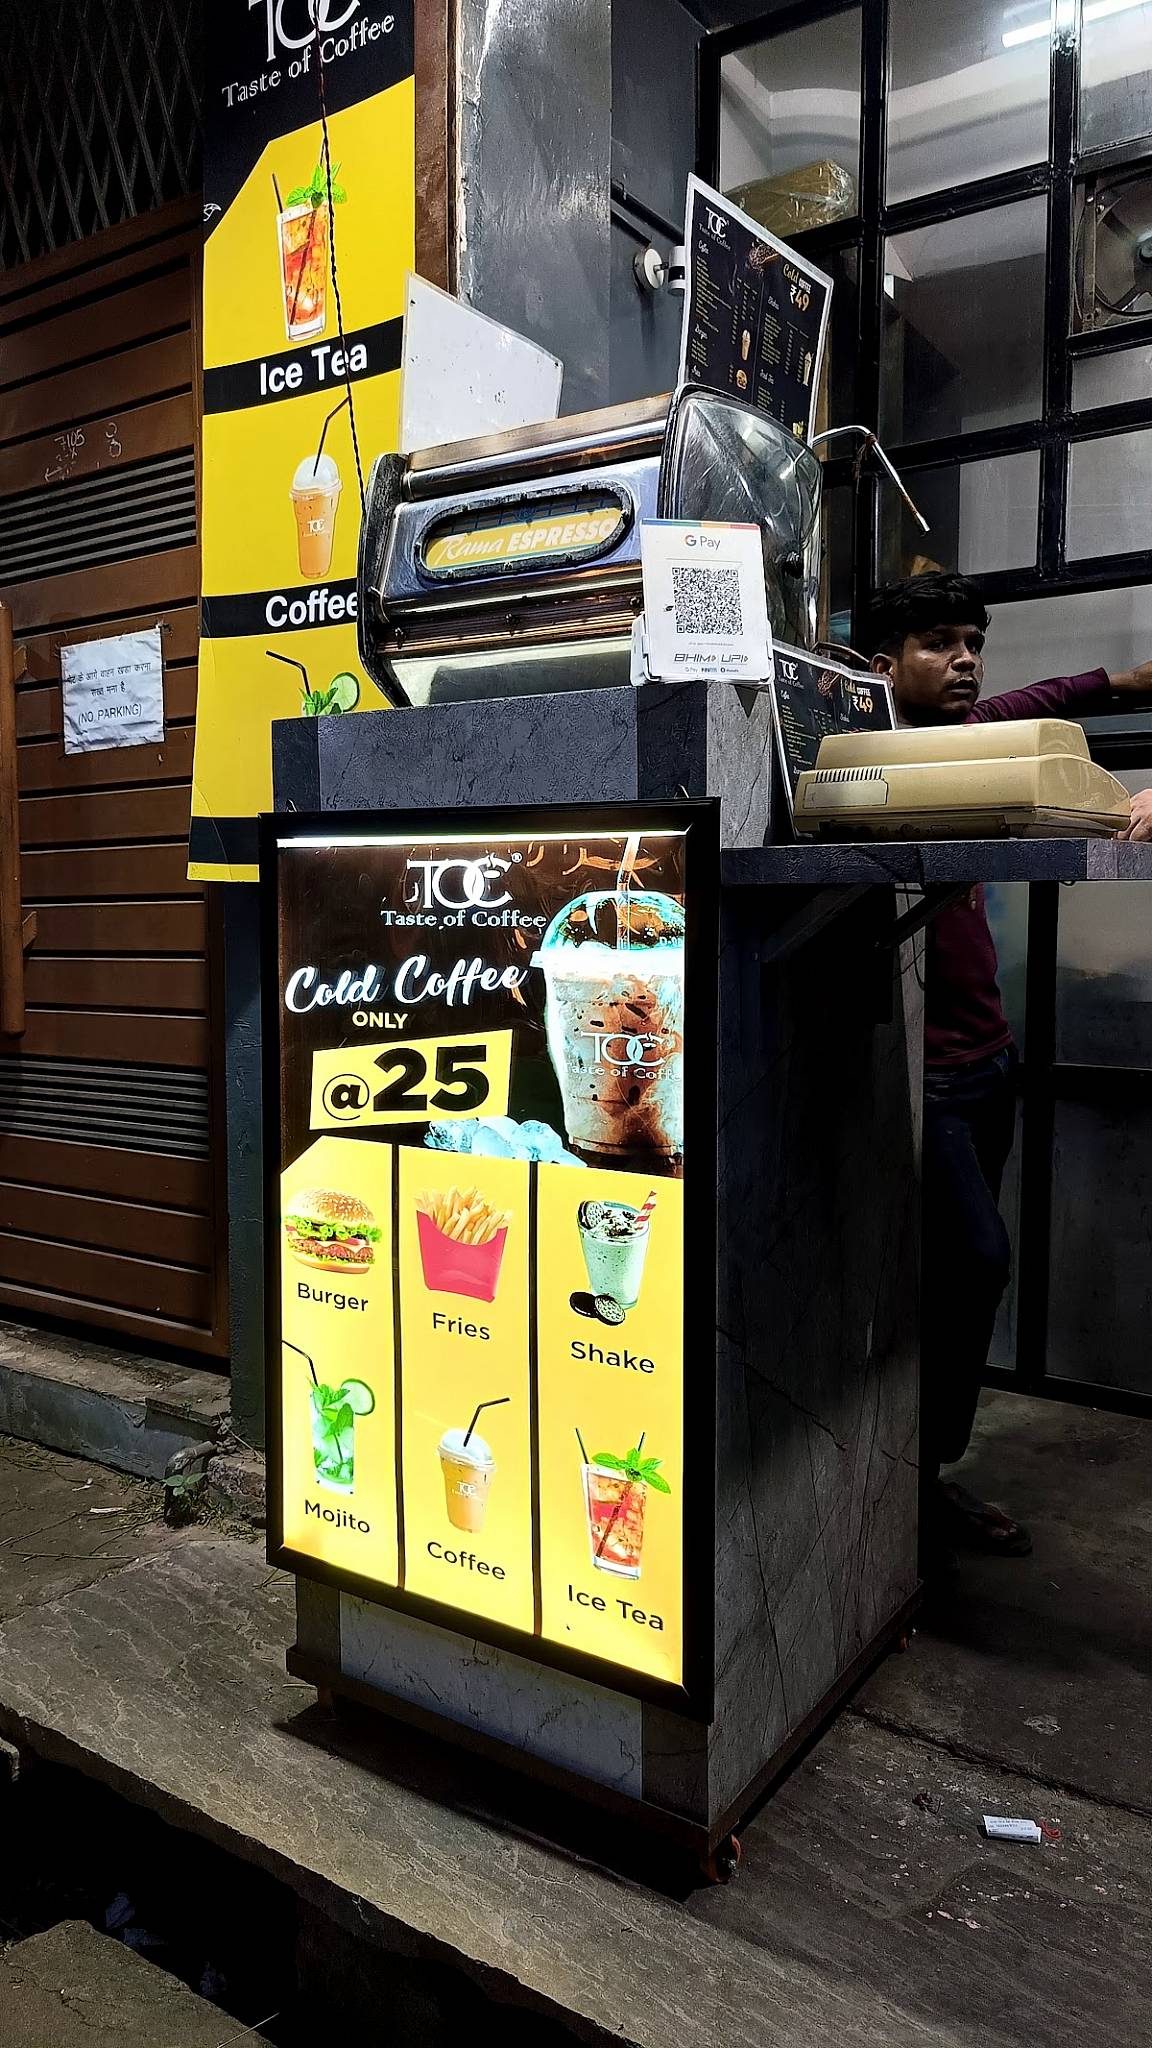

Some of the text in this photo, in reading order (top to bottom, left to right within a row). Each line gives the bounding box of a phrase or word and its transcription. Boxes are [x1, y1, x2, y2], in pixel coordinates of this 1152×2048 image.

[222, 14, 395, 107] Taste of Coffee
[783, 263, 799, 284] Cold
[260, 345, 368, 395] Ice Tea
[507, 518, 617, 552] ESPRESSO
[685, 535, 721, 550] G Pay
[265, 588, 358, 628] Coffee
[674, 653, 711, 662] BHIM
[78, 703, 142, 726] (NO PARKING)
[852, 695, 873, 713] ₹49
[380, 910, 547, 928] Taste of Coffee
[285, 954, 529, 1014] Cold Coffee
[351, 1010, 408, 1030] ONLY
[322, 1045, 490, 1121] @25
[610, 1066, 629, 1078] of
[297, 1281, 369, 1312] Burger
[432, 1311, 491, 1341] Fries
[570, 1340, 655, 1375] Shake
[304, 1498, 371, 1534] Mojito
[427, 1541, 506, 1581] Coffee
[568, 1583, 665, 1632] Ice Tea
